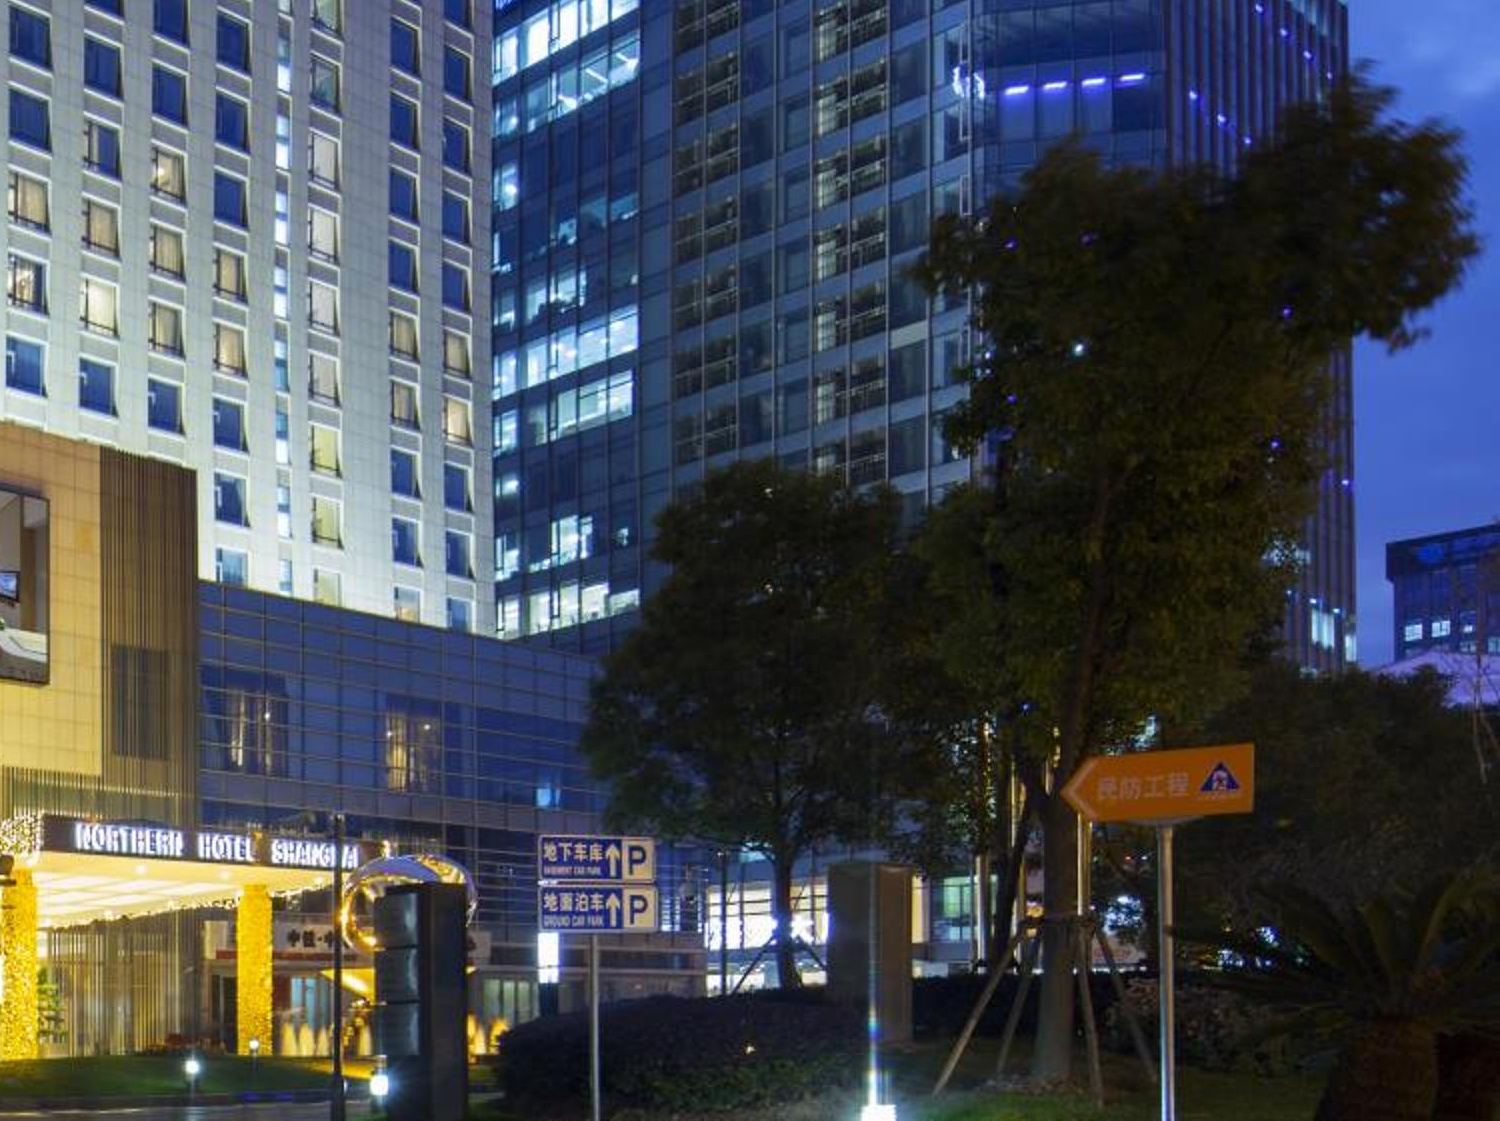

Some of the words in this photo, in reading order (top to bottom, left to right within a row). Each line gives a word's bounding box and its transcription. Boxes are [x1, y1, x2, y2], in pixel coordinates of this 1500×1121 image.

[1096, 772, 1190, 800] 民防工程
[74, 822, 184, 858] NORTHERN
[197, 831, 255, 863] HOTEL
[543, 842, 604, 862] 地下车库
[628, 845, 647, 876] P
[543, 892, 605, 912] 地面泊车
[629, 894, 648, 925] P
